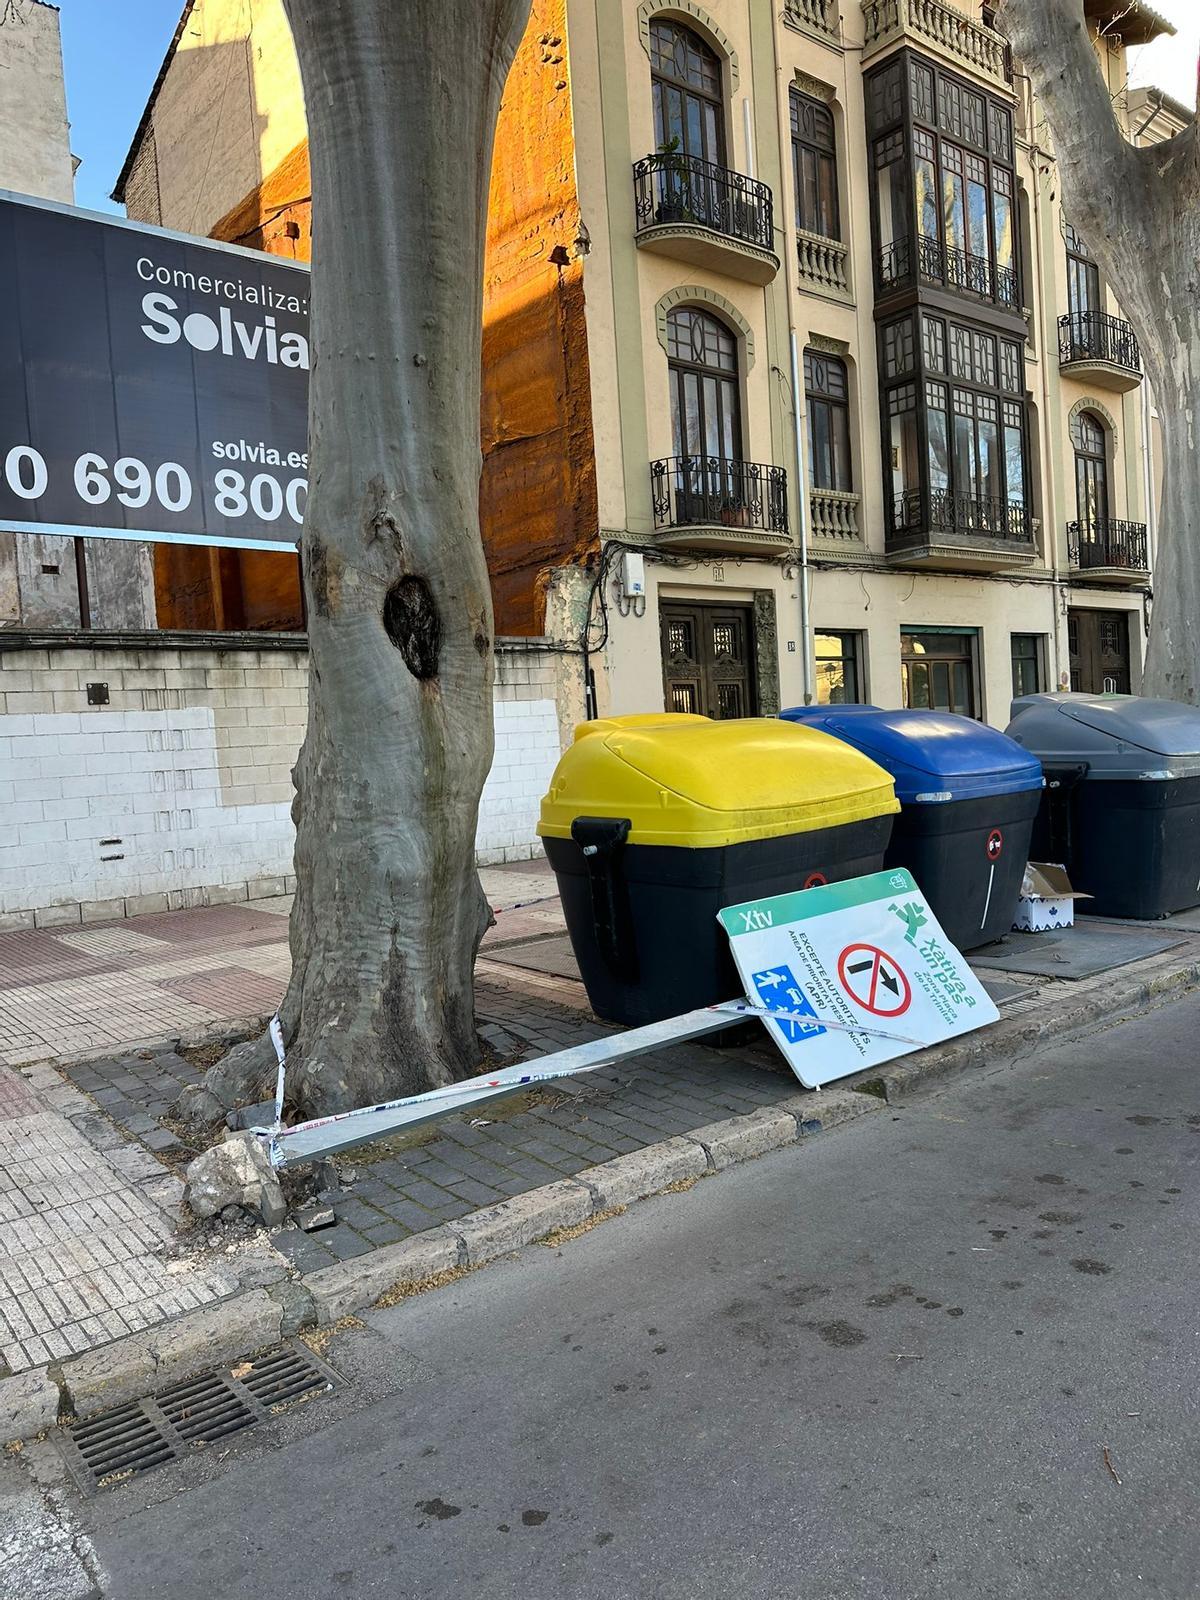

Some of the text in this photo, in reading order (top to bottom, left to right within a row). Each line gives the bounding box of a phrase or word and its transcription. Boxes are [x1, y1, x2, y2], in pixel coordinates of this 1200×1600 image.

[136, 257, 308, 315] Comercializa:
[140, 292, 310, 370] Solvia
[73, 452, 192, 512] 690
[212, 439, 309, 470] solvia.es
[739, 909, 773, 932] Xtv
[799, 932, 871, 1045] EXCEPTE AUTORITZTS
[800, 951, 809, 963] DE
[806, 963, 833, 1006] PRIORITAT
[805, 981, 827, 1010] (APR)
[914, 971, 954, 1025] de la Trinitat
[919, 947, 963, 1004] un pas
[923, 971, 940, 993] Zona
[924, 938, 976, 1008] Xàtiva a
